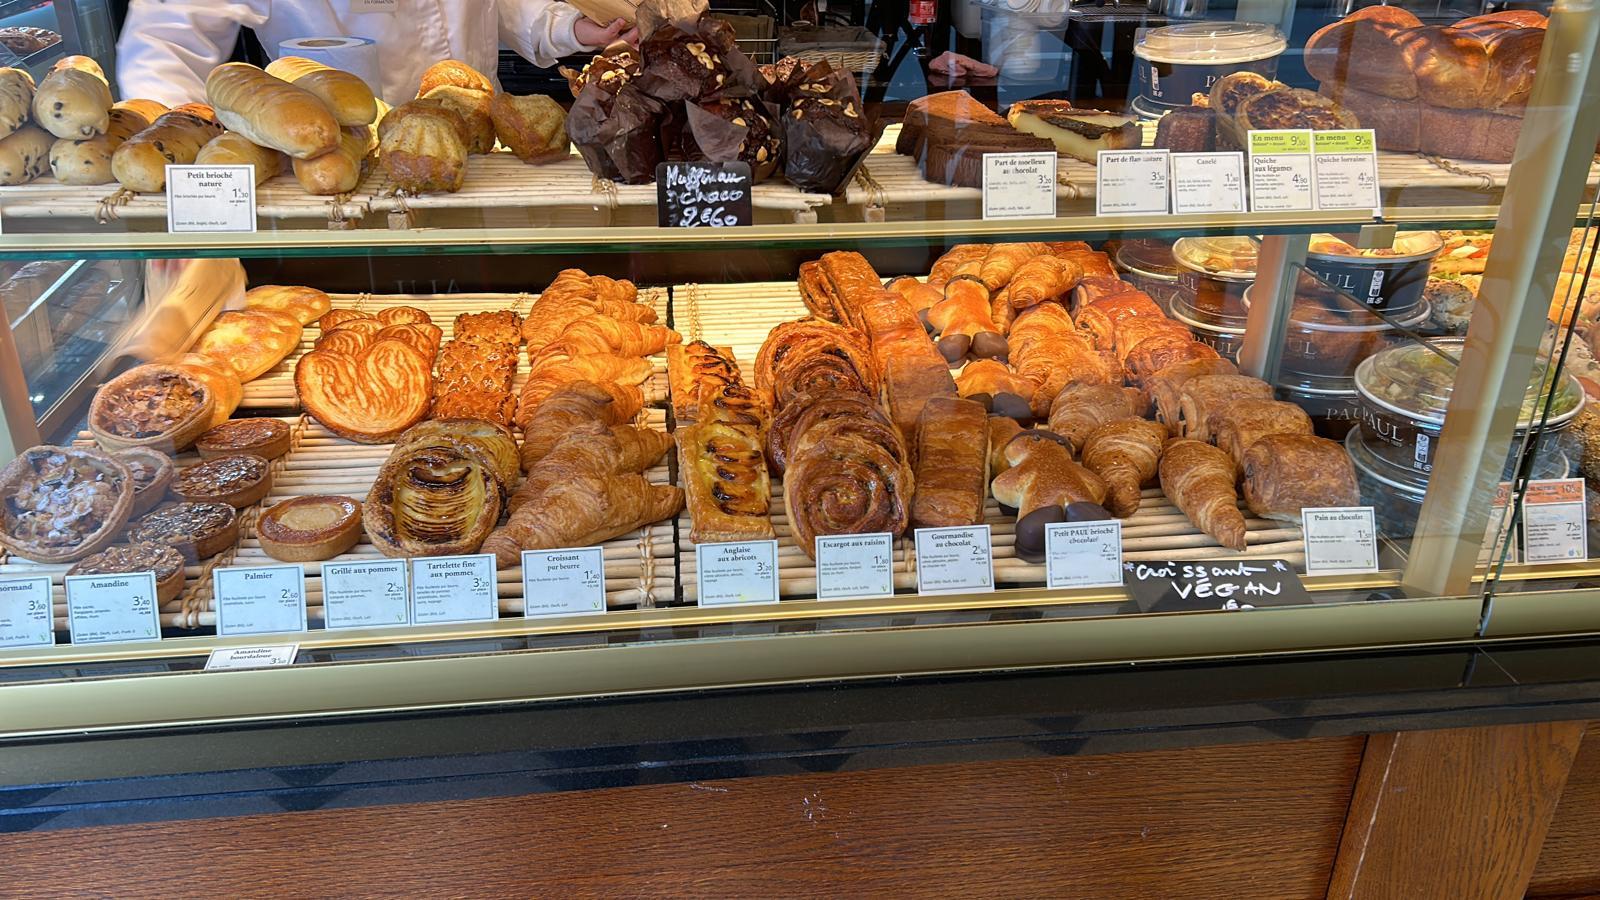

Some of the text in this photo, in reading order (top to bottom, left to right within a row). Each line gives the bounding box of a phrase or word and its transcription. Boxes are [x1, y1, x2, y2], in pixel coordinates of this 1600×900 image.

[1254, 157, 1276, 165] Quiche
[1317, 157, 1340, 165] Quiche
[1267, 165, 1292, 173] légumes
[1361, 406, 1404, 442] PAUL
[1314, 513, 1329, 522] Pain
[1338, 513, 1363, 521] chocolat
[931, 532, 974, 541] Gourmandise
[1070, 529, 1089, 537] PAUL
[823, 540, 850, 549] Escargot
[945, 539, 971, 548] chocolat
[723, 547, 751, 556] Anglaise
[547, 554, 580, 563] Croissant
[731, 554, 757, 562] abricots
[427, 561, 477, 570] Tartelette fine
[547, 563, 580, 573] pur beurre
[331, 566, 352, 576] Grillé
[368, 566, 398, 576] pommes
[444, 571, 474, 580] pommes
[245, 572, 273, 580] Palmier
[90, 581, 129, 589] Amandine
